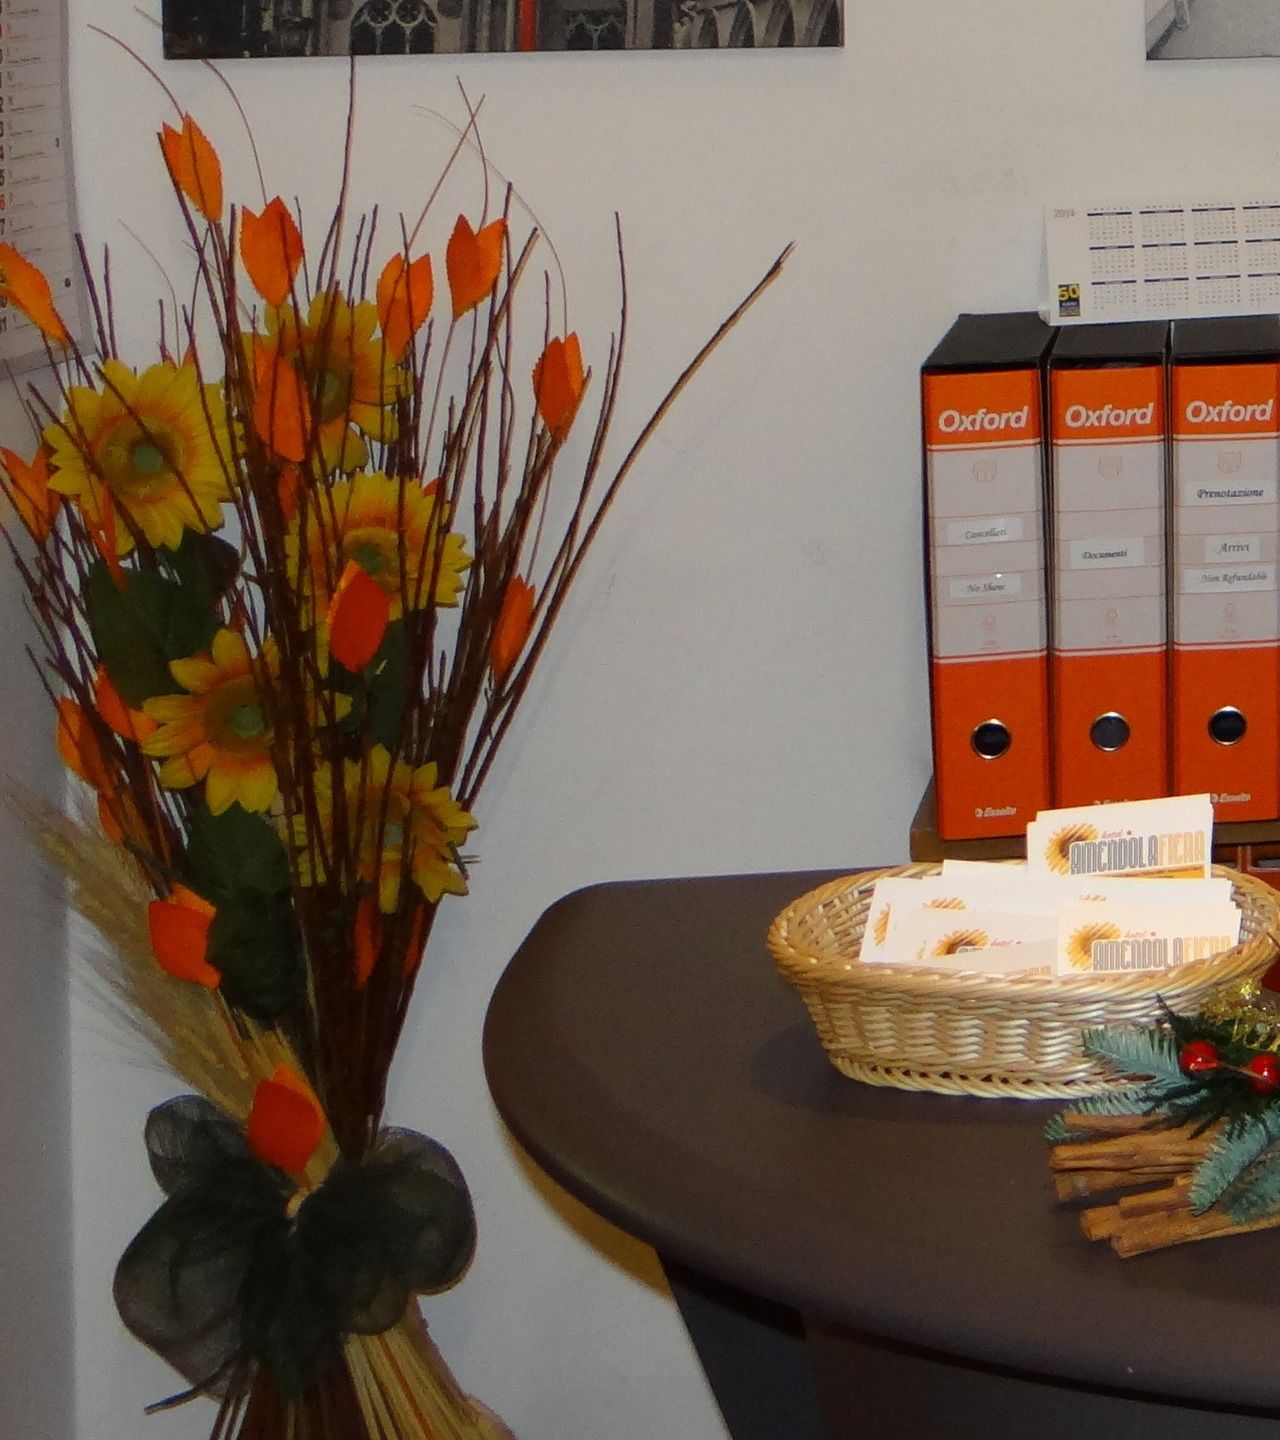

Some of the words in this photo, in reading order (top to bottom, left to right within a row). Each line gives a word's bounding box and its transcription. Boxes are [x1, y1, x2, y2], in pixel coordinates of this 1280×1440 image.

[1053, 209, 1076, 218] 2014
[1064, 402, 1154, 428] Oxford
[1185, 399, 1273, 424] Oxford
[937, 405, 1029, 433] Oxford
[1197, 488, 1264, 498] Prenotazione
[1082, 548, 1128, 560] Documenti
[1217, 543, 1250, 554] Arrivi
